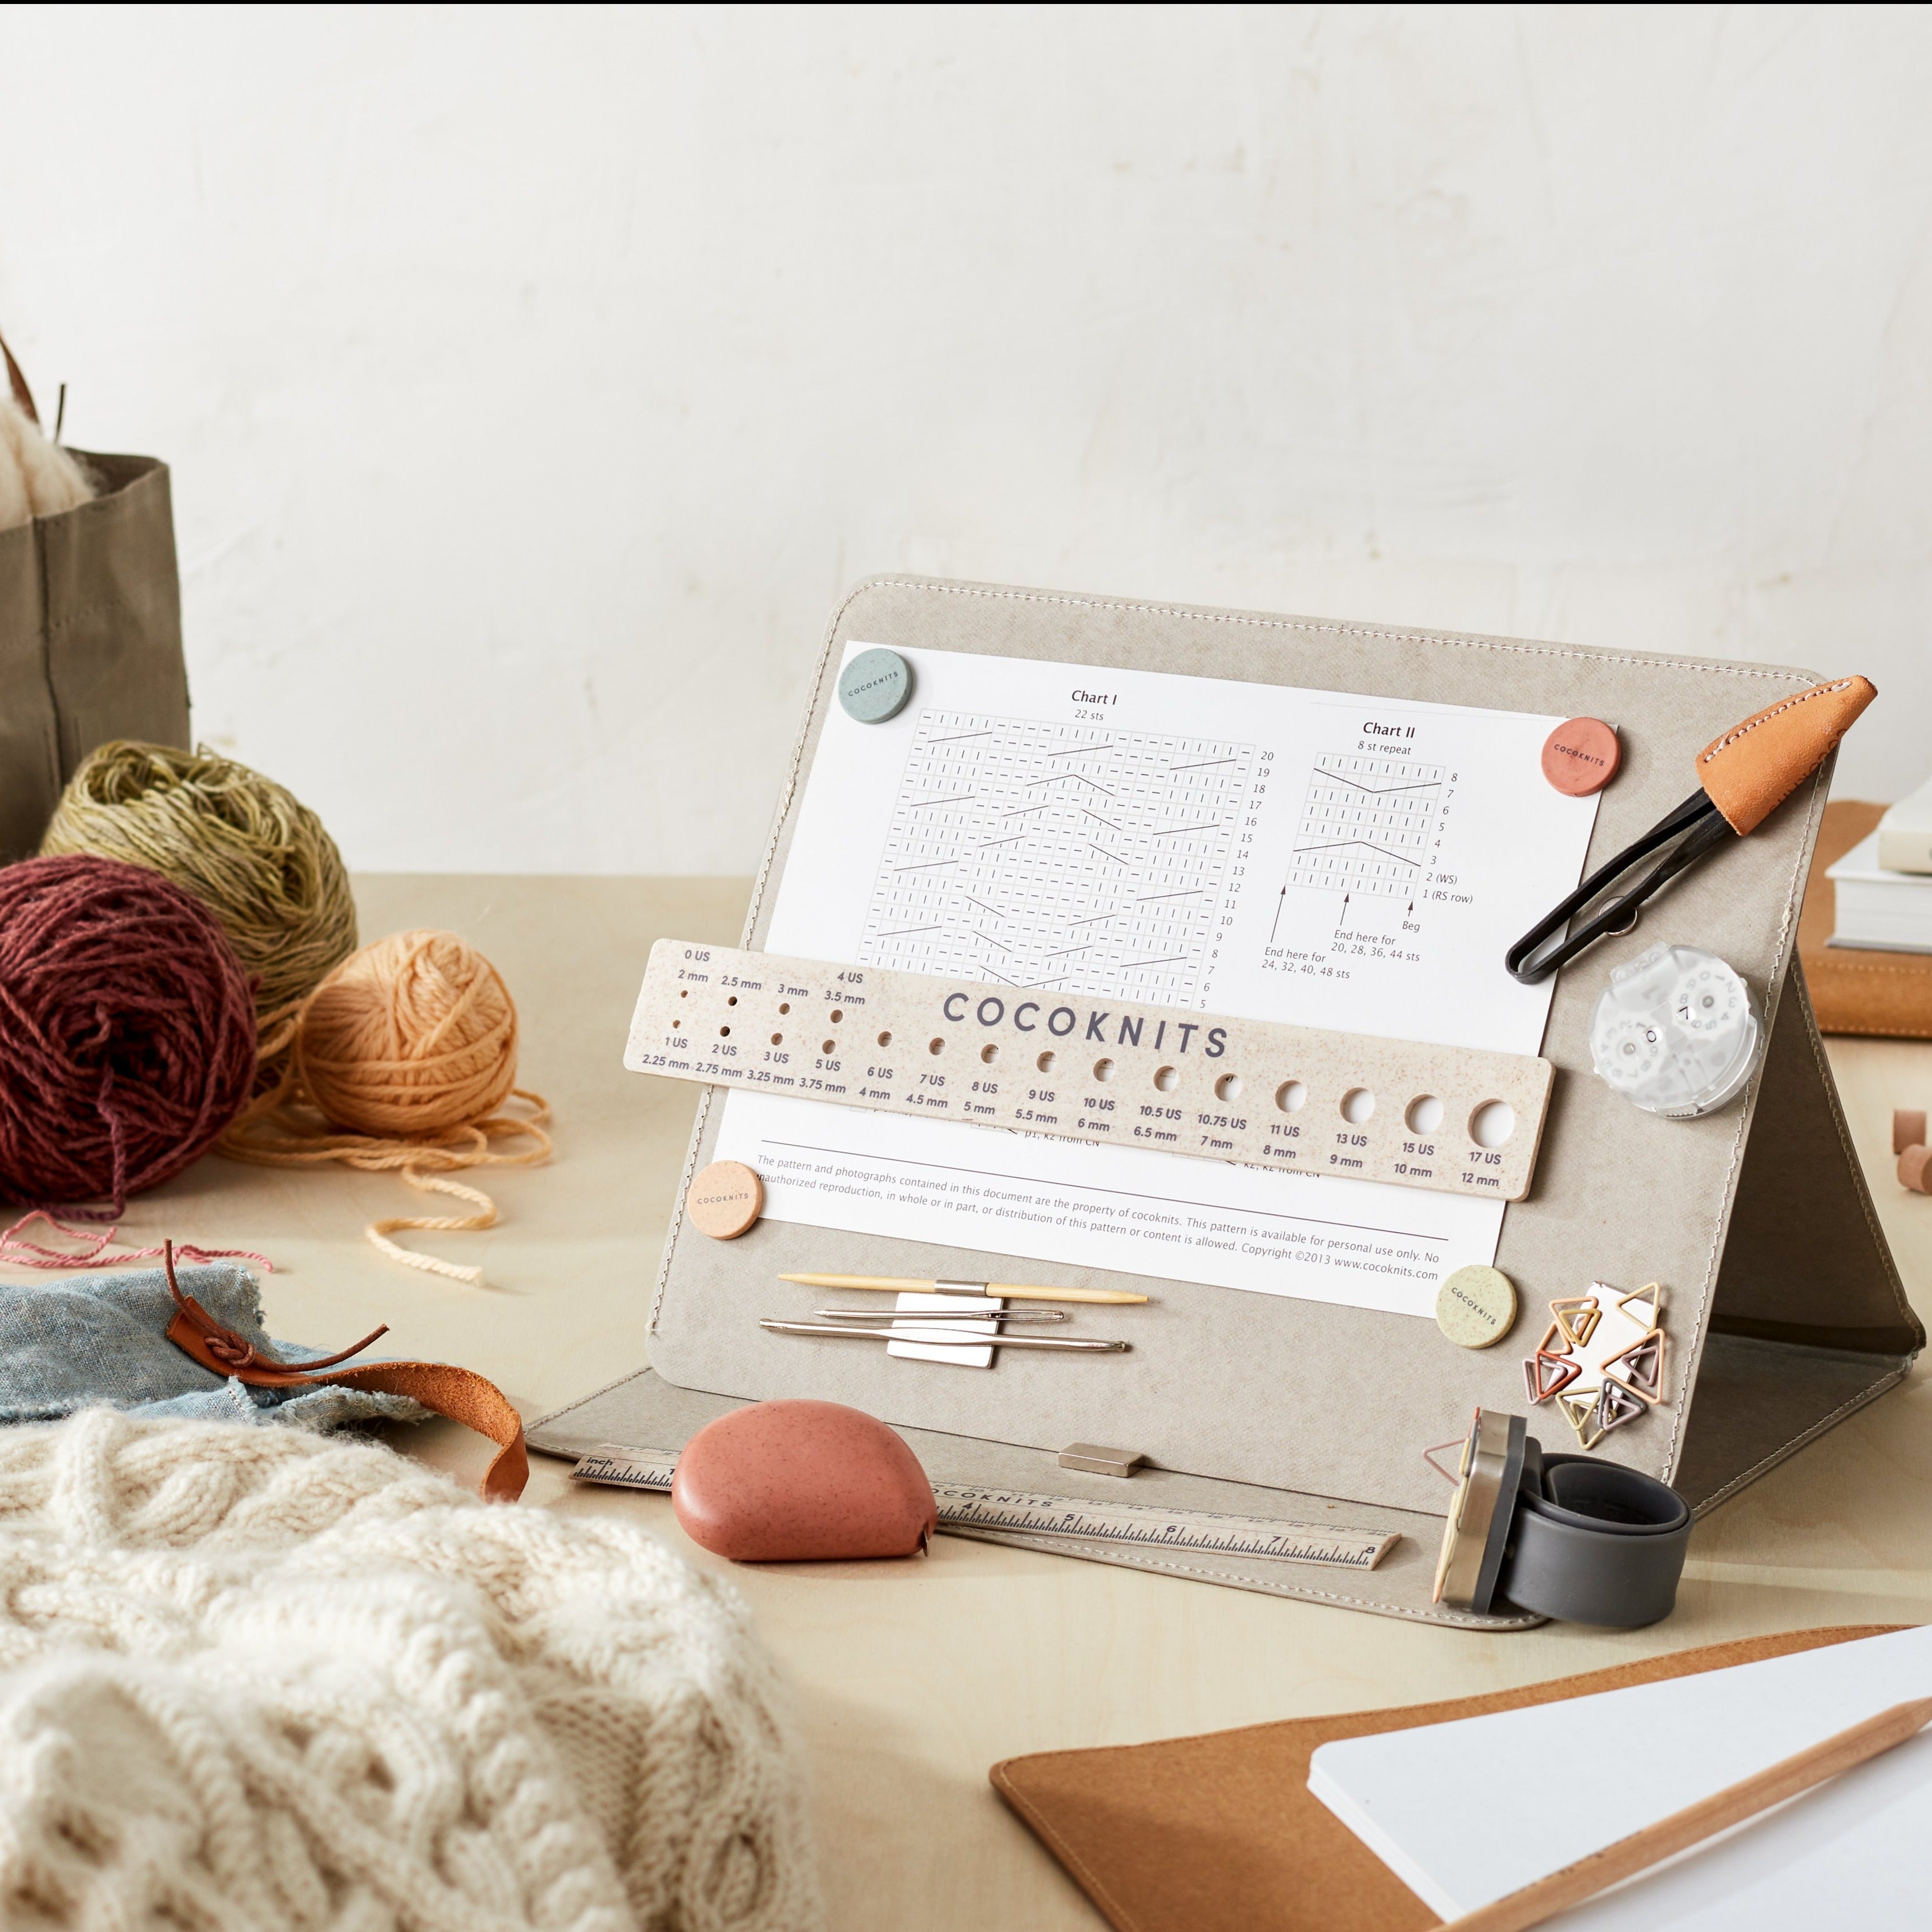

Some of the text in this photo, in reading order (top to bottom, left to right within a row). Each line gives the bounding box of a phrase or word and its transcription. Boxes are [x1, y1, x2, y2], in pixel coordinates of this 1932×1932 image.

[848, 671, 899, 697] COCOKNITS
[1071, 690, 1117, 706] Chart I
[1074, 709, 1104, 721] 22 sts
[1363, 722, 1416, 739] Chart II
[1358, 740, 1412, 755] 8 st repeat
[1553, 743, 1605, 767] COCOKNITS
[1260, 751, 1274, 761] 20
[1451, 772, 1458, 782] 8
[1253, 784, 1266, 794] 18
[1245, 816, 1258, 827] 16
[1236, 850, 1249, 859] 14
[1426, 872, 1458, 886] 2 (WS)
[1228, 883, 1241, 893] 12
[1422, 889, 1473, 905] 1 (RS row)
[1220, 916, 1233, 926] 10
[1402, 920, 1420, 933] Beg
[1334, 929, 1396, 945] End here for
[685, 949, 710, 962] 0 US
[1265, 947, 1327, 963] End here for
[1331, 941, 1420, 961] 20, 28, 36, 44 sts
[678, 969, 709, 983] 2 mm
[1261, 959, 1350, 979] 24, 32, 40, 48 sts
[721, 975, 762, 991] 2.5 mm
[836, 971, 863, 984] 4 US
[778, 983, 808, 997] 3 mm
[824, 990, 866, 1005] 3.5 mm
[943, 992, 1227, 1058] COCOKNITS
[665, 1036, 688, 1049] 1 US
[711, 1044, 738, 1056] 2 US
[642, 1054, 690, 1070] 2.25 mm
[815, 1058, 841, 1072] 5 US
[695, 1062, 743, 1078] 2.75 mm
[747, 1069, 795, 1086] 3.25 mm
[799, 1077, 846, 1094] 3.75 mm
[920, 1073, 945, 1086] 7 US
[905, 1093, 948, 1108] 4.5 mm
[1028, 1089, 1056, 1102] 9 US
[1084, 1097, 1116, 1111] 10 US
[1015, 1108, 1057, 1124] 5.5 mm
[1140, 1105, 1182, 1121] 10.5 US
[1198, 1113, 1247, 1130] 10.75 US
[1133, 1126, 1178, 1141] 6.5 mm
[1270, 1124, 1300, 1138] 11 US
[1336, 1133, 1368, 1147] 13 US
[1263, 1144, 1297, 1159] 8 mm
[1402, 1142, 1435, 1156] 15 US
[1470, 1151, 1502, 1165] 17 US
[1394, 1163, 1432, 1178] 10 mm
[1462, 1172, 1499, 1187] 12 mm
[697, 1193, 748, 1205] COCOKNITS
[758, 1154, 1439, 1263] The pattern and photographs contained in this document are the property of cocoknits. This pattern is available for personal use only. No
[757, 1172, 817, 1189] nauthorized
[819, 1183, 883, 1200] reproduction,
[886, 1190, 896, 1201] in
[899, 1193, 928, 1205] whole
[944, 1201, 953, 1209] in
[955, 1203, 979, 1214] part,
[981, 1206, 993, 1215] or
[995, 1207, 1053, 1223] distribution
[1056, 1215, 1068, 1226] of
[1069, 1217, 1088, 1229] this
[1089, 1222, 1126, 1235] pattern
[1129, 1228, 1141, 1237] or
[1143, 1230, 1182, 1243] content
[1184, 1234, 1193, 1245] is
[1195, 1236, 1238, 1251] allowed.
[1241, 1243, 1293, 1259] Copyright
[1334, 1258, 1438, 1281] www.cocoknits.com
[1451, 1287, 1496, 1325] COCOKNITS
[586, 1457, 613, 1466] inch
